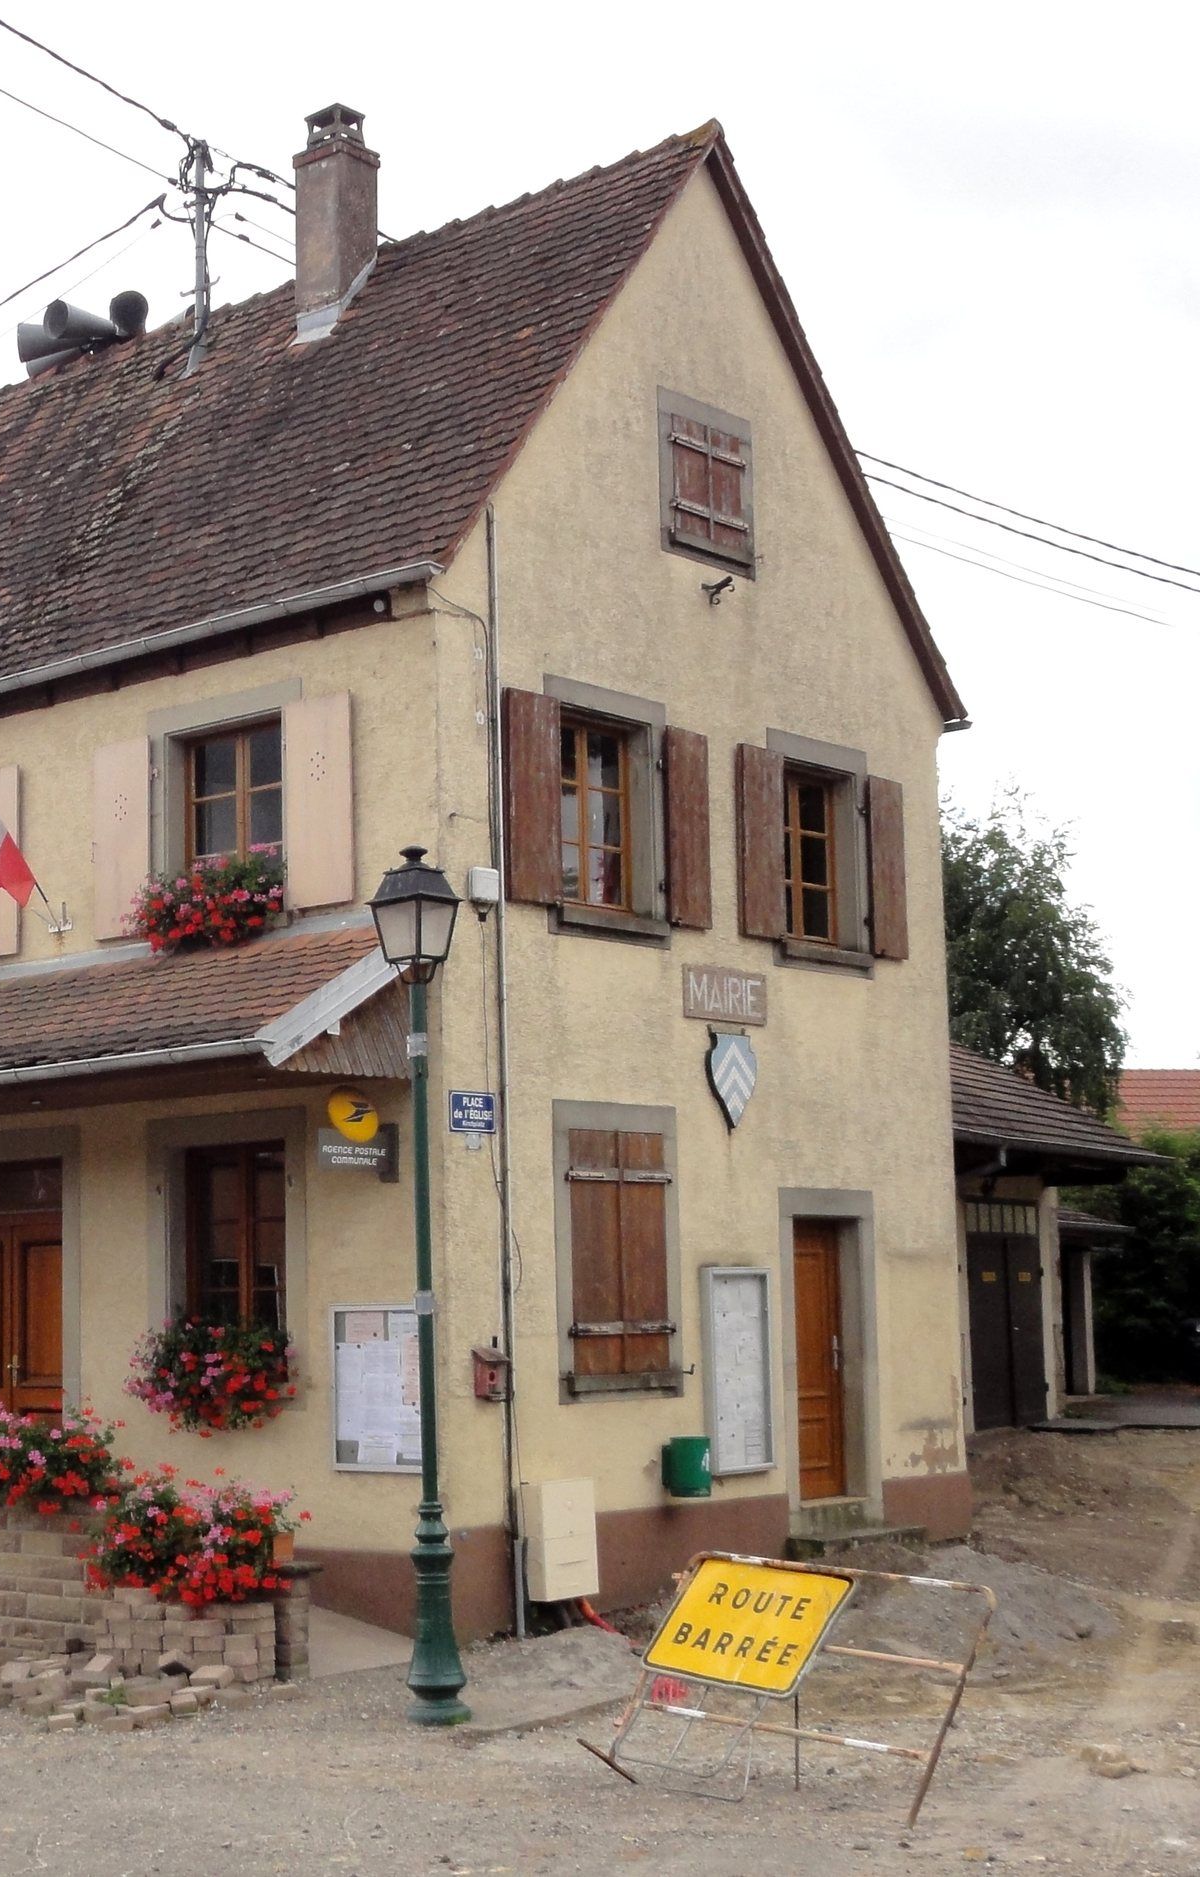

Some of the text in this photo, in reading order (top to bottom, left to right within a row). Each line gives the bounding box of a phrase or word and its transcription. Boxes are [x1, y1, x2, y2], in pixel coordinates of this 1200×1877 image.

[689, 971, 762, 1017] MAIRIE
[462, 1096, 484, 1108] PLACE
[453, 1109, 463, 1119] de
[322, 1145, 387, 1156] AGENCE POSTALE
[331, 1156, 378, 1166] COMMUNALE
[707, 1582, 812, 1620] ROUTE
[672, 1622, 799, 1666] BARRÉE
